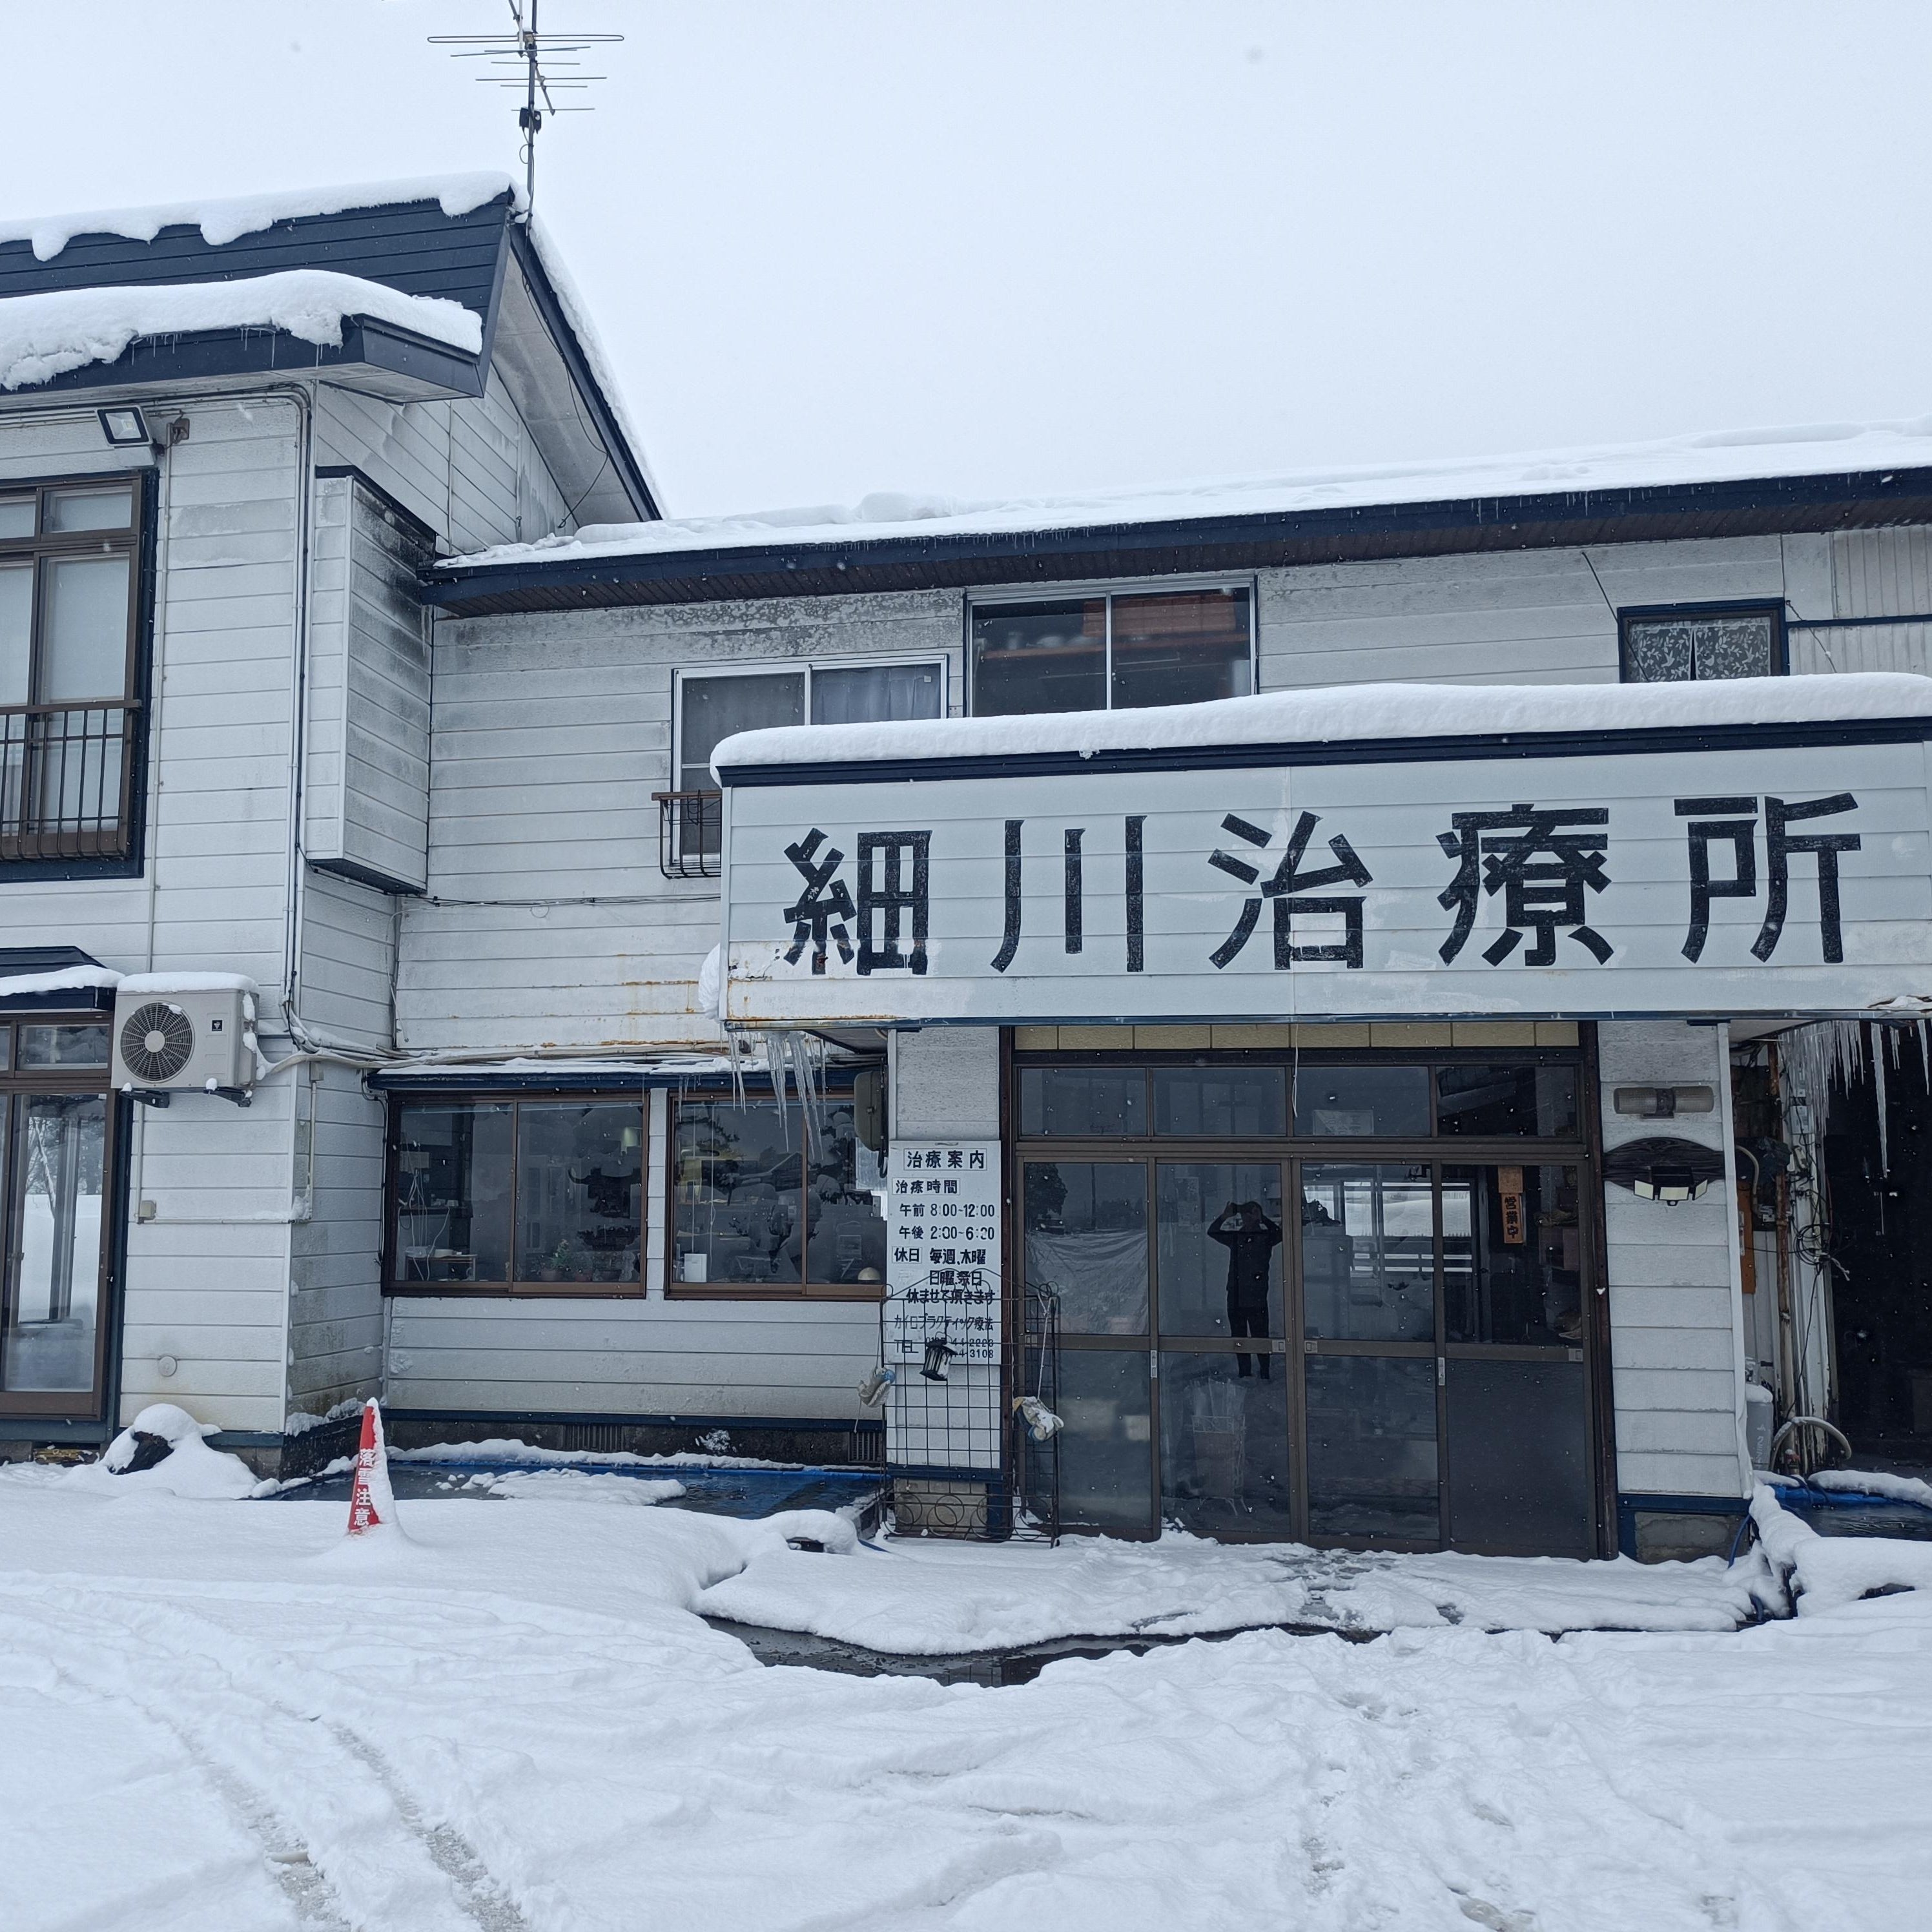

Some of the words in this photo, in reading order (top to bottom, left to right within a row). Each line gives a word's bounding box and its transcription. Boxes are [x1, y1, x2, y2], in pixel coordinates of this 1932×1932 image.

[784, 792, 1862, 976] 細川治療所
[907, 1150, 985, 1169] 治療案内
[896, 1180, 958, 1194] 治療時間
[899, 1203, 925, 1217] 午前
[1505, 1196, 1519, 1238] 営業中
[899, 1226, 923, 1240] 午後
[894, 1248, 920, 1262] 休日
[906, 1288, 995, 1305] 休ませて頂きます
[894, 1313, 994, 1331] カイロプラクティック療法
[894, 1339, 919, 1353] TEL
